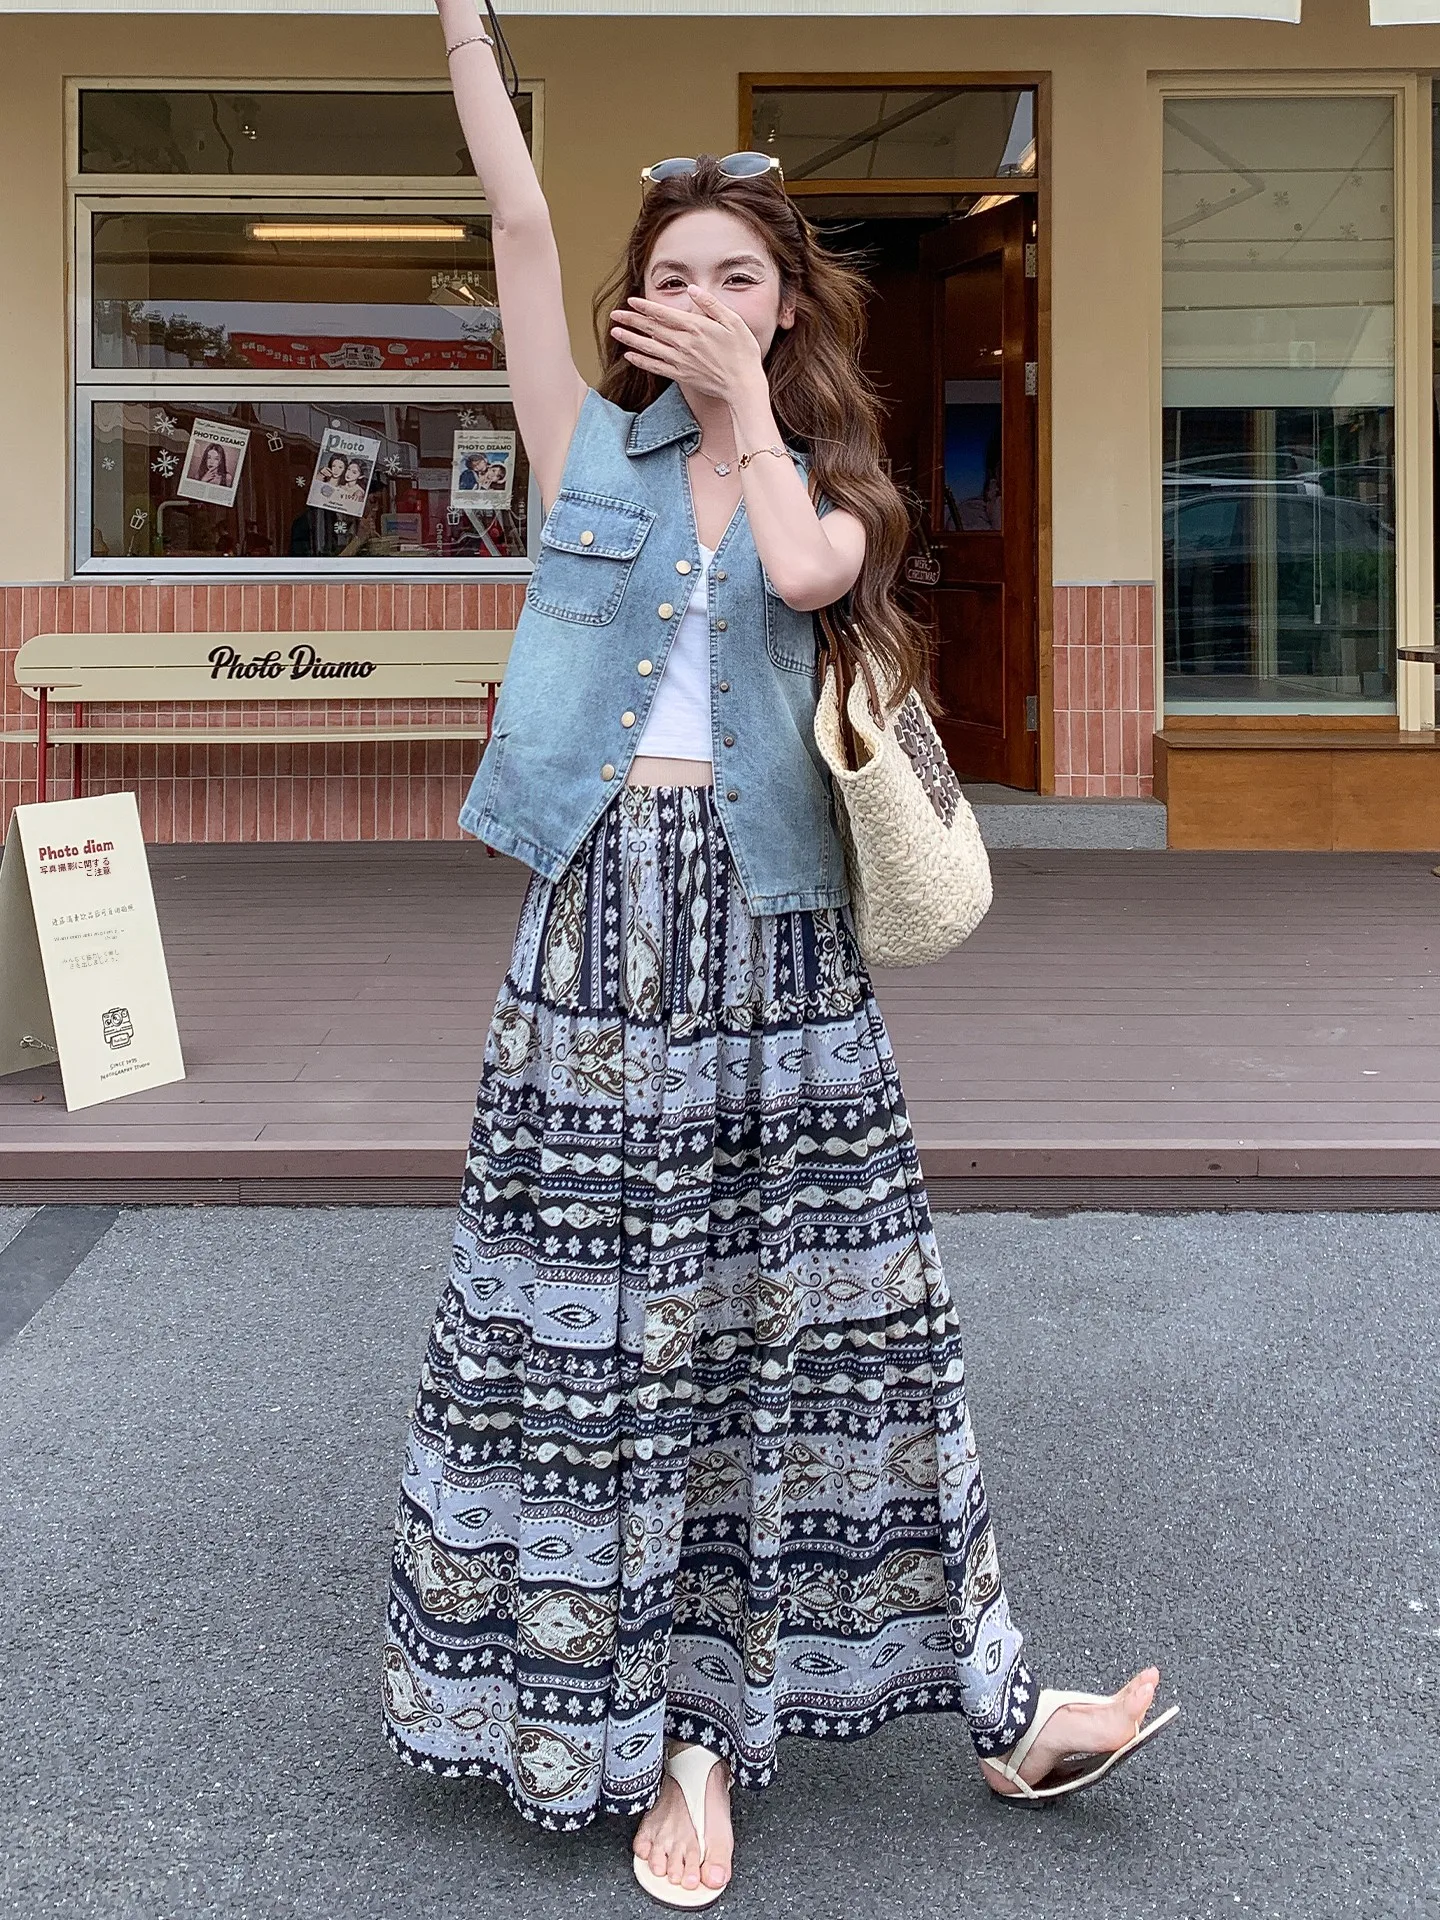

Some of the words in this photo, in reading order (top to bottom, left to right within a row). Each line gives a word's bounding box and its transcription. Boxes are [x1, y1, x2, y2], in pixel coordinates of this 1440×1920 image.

[193, 430, 218, 441] PHOTO
[220, 436, 246, 447] DIAMO
[207, 644, 286, 680] Photo
[288, 643, 377, 680] Diamo
[38, 845, 79, 861] Photo
[83, 839, 115, 854] diam
